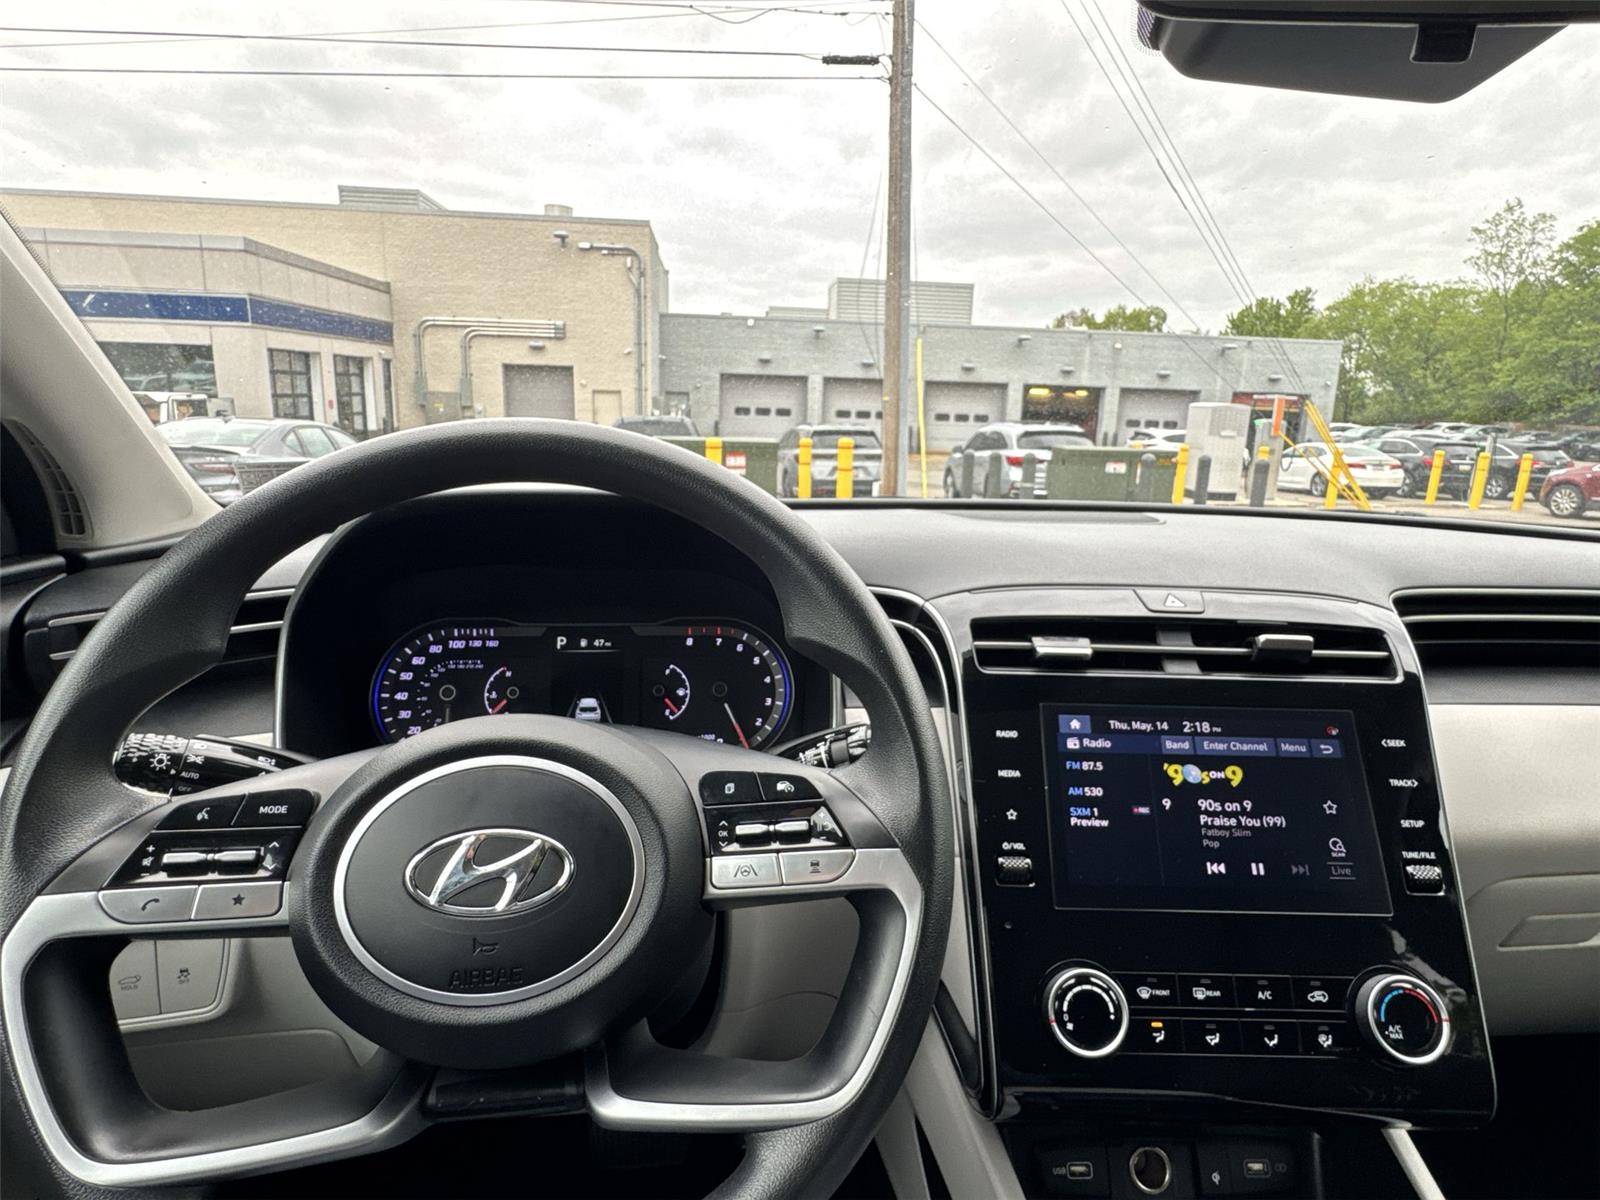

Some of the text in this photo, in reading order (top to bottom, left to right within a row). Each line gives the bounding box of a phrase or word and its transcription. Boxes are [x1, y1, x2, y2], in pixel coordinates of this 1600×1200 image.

[448, 640, 465, 649] 100
[468, 640, 483, 648] 130
[557, 636, 567, 650] P
[593, 639, 605, 647] 47
[686, 637, 694, 646] 8
[715, 637, 723, 646] 7
[429, 644, 443, 654] 80
[736, 643, 744, 652] 6
[411, 656, 426, 665] 60
[753, 656, 761, 665] 5
[400, 671, 414, 681] 50
[764, 676, 771, 684] 4
[394, 692, 409, 701] 40
[765, 697, 772, 706] 3
[398, 710, 412, 719] 30
[755, 717, 763, 726] 2
[1156, 721, 1169, 731] 14
[1182, 721, 1210, 733] 2:18
[996, 730, 1019, 738] RADIO
[1082, 738, 1112, 749] Radio
[1166, 740, 1190, 750] Band
[1203, 741, 1268, 752] Enter Channel
[1281, 743, 1307, 753] Menu
[1066, 761, 1103, 771] FM 87.5
[180, 771, 200, 780] AUTO
[998, 770, 1021, 778] MEDIA
[1068, 786, 1103, 797] AM 530
[1162, 798, 1171, 810] 9
[1198, 799, 1252, 812] 90s on 9
[259, 805, 288, 814] MODE
[1070, 806, 1098, 817] SXM 1
[1070, 817, 1109, 827] Preview
[1200, 814, 1286, 828] Praise You (99)
[1400, 820, 1425, 828] SETUP
[1201, 828, 1251, 839] Fatboy Slim
[1203, 839, 1220, 849] Pop
[1331, 865, 1351, 876] Live
[450, 967, 524, 989] AIRBAG
[1257, 990, 1273, 1000] A/C
[1388, 1025, 1402, 1033] A/C
